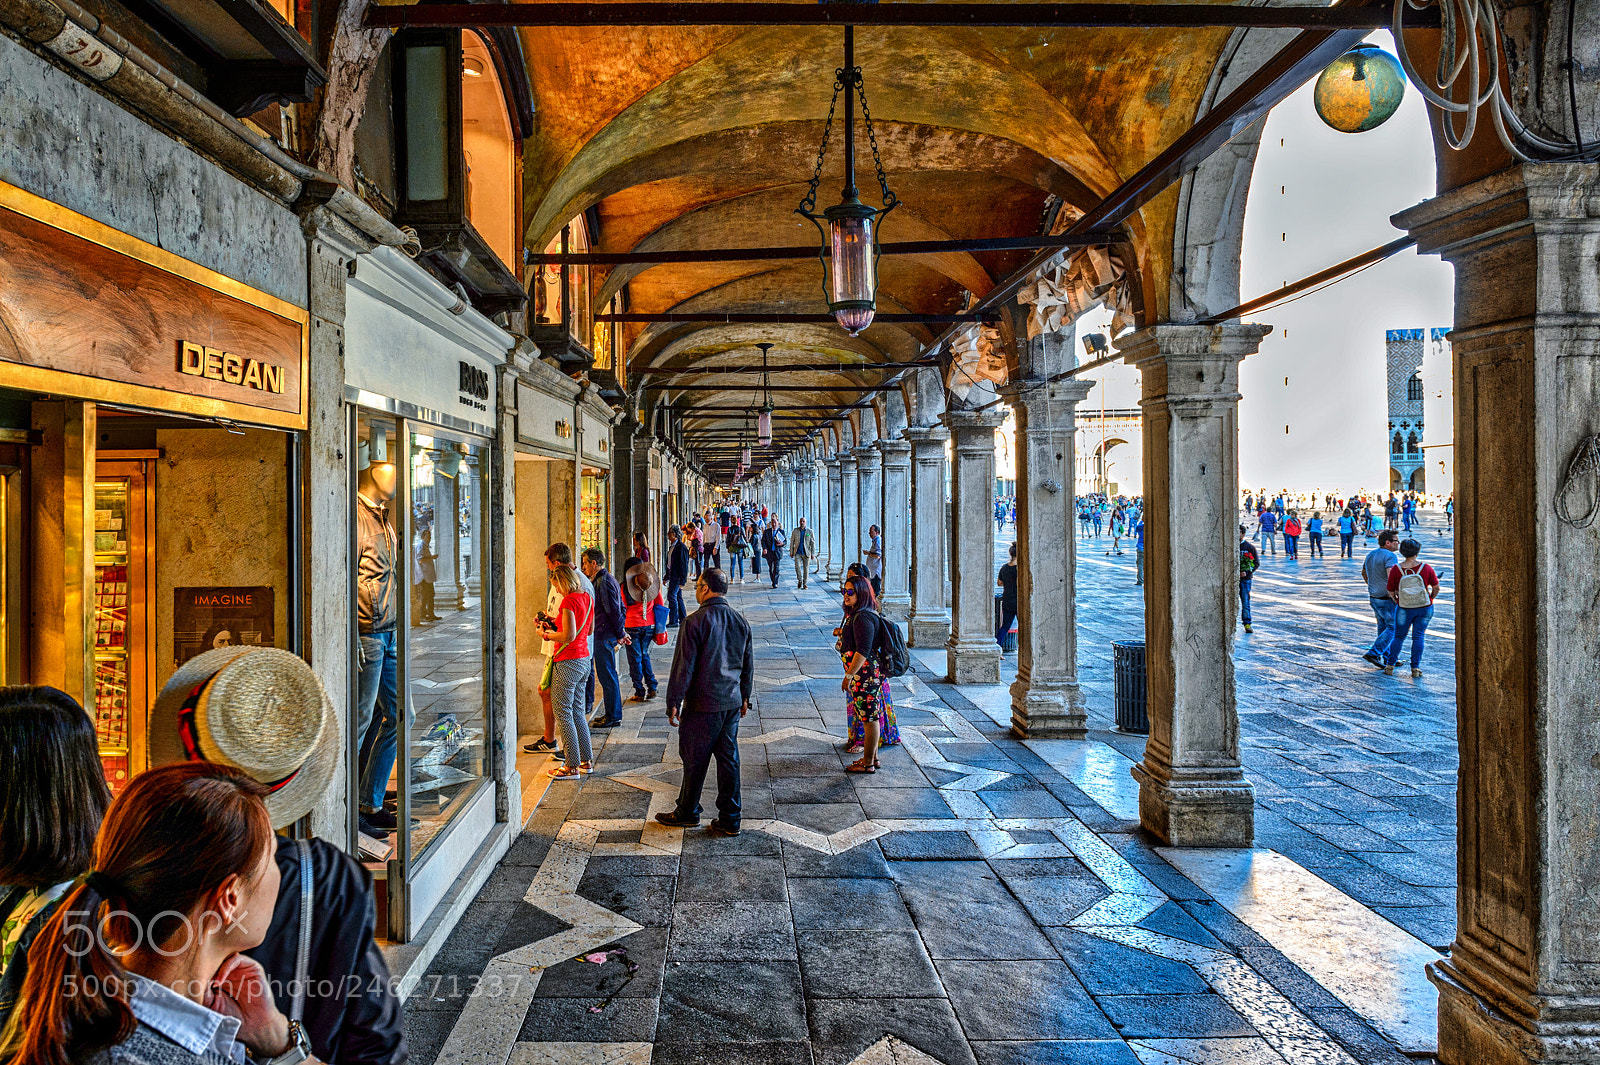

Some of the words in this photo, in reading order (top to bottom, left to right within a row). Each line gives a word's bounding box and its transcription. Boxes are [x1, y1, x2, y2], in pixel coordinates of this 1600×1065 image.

[66, 38, 103, 67] 79
[177, 340, 286, 394] DEGANI
[194, 594, 253, 605] IMAGINE
